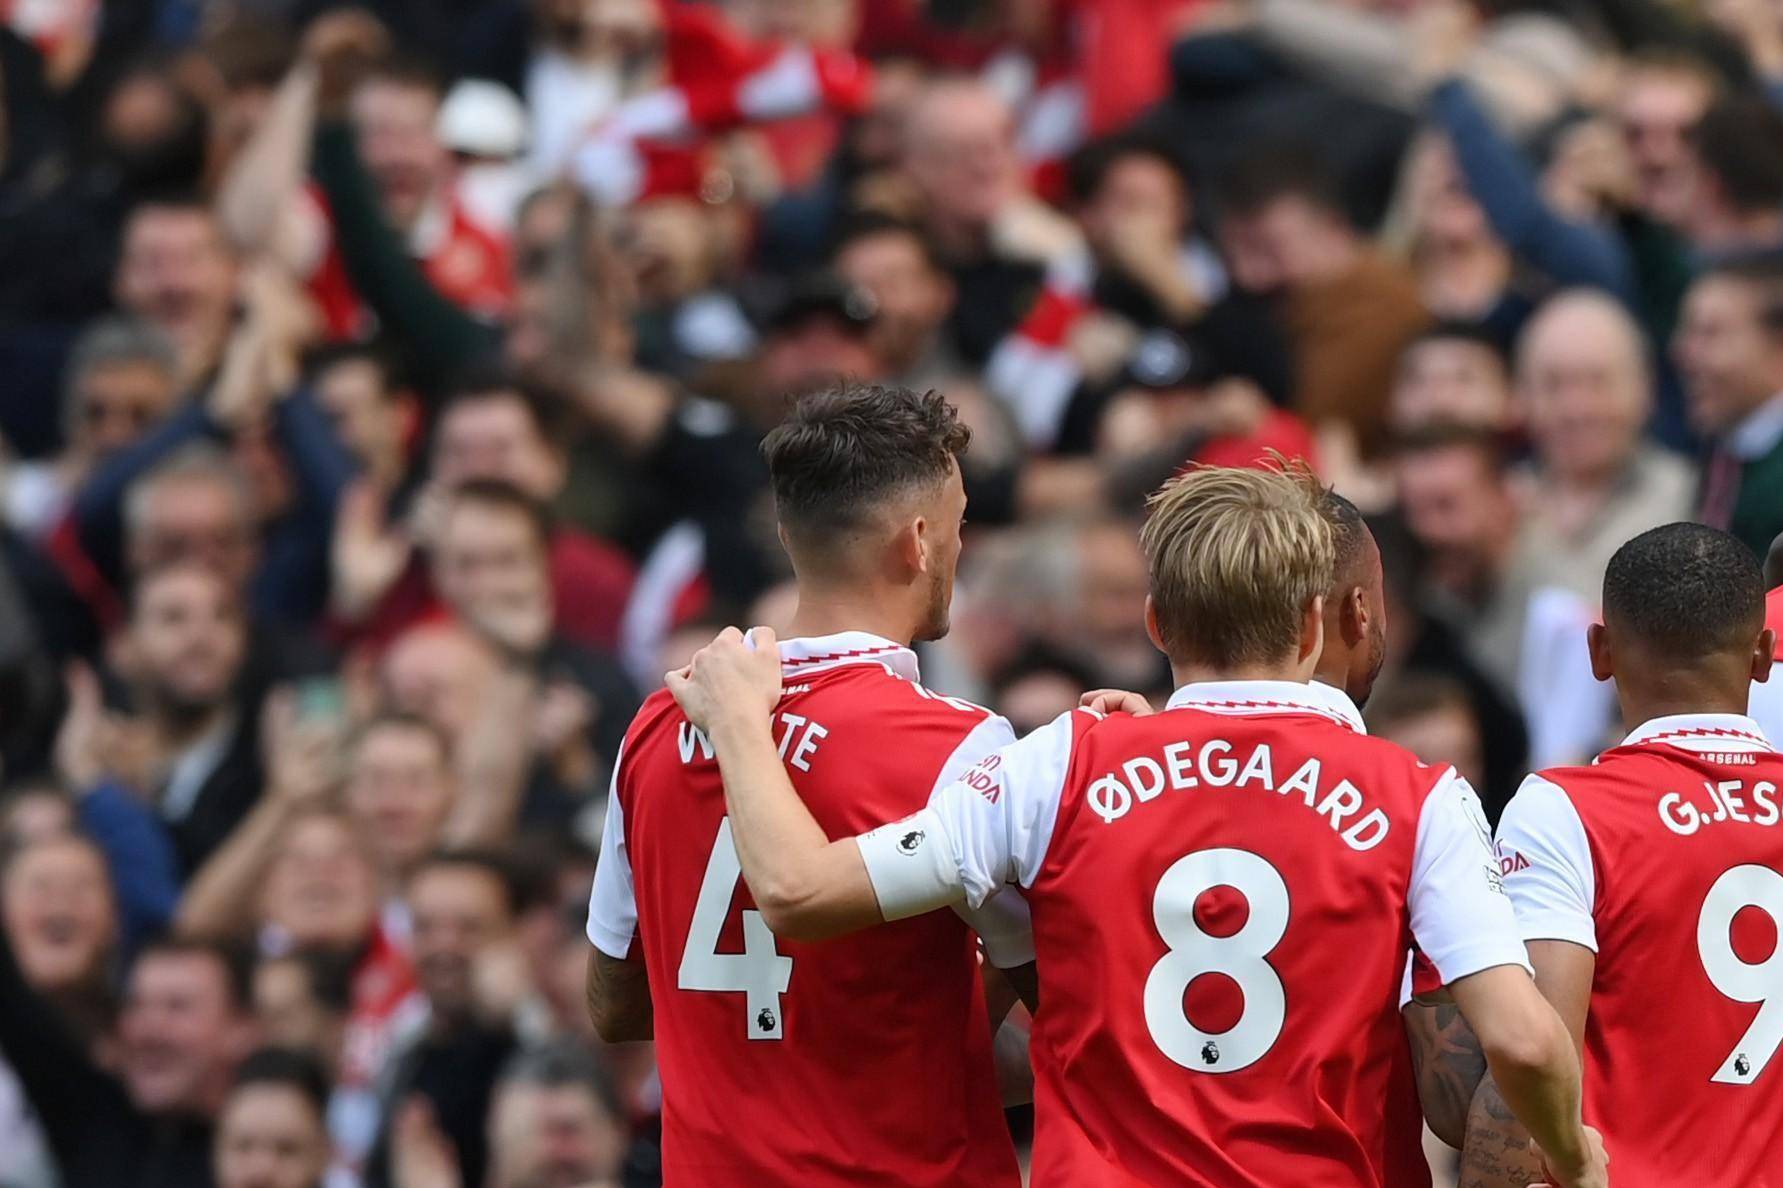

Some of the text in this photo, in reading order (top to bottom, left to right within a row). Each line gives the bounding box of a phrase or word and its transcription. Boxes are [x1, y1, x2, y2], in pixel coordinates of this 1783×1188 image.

[678, 712, 829, 773] WTE
[1087, 739, 1389, 851] ØDEGAARD
[677, 815, 793, 1041] 4
[1142, 846, 1291, 1075] 8
